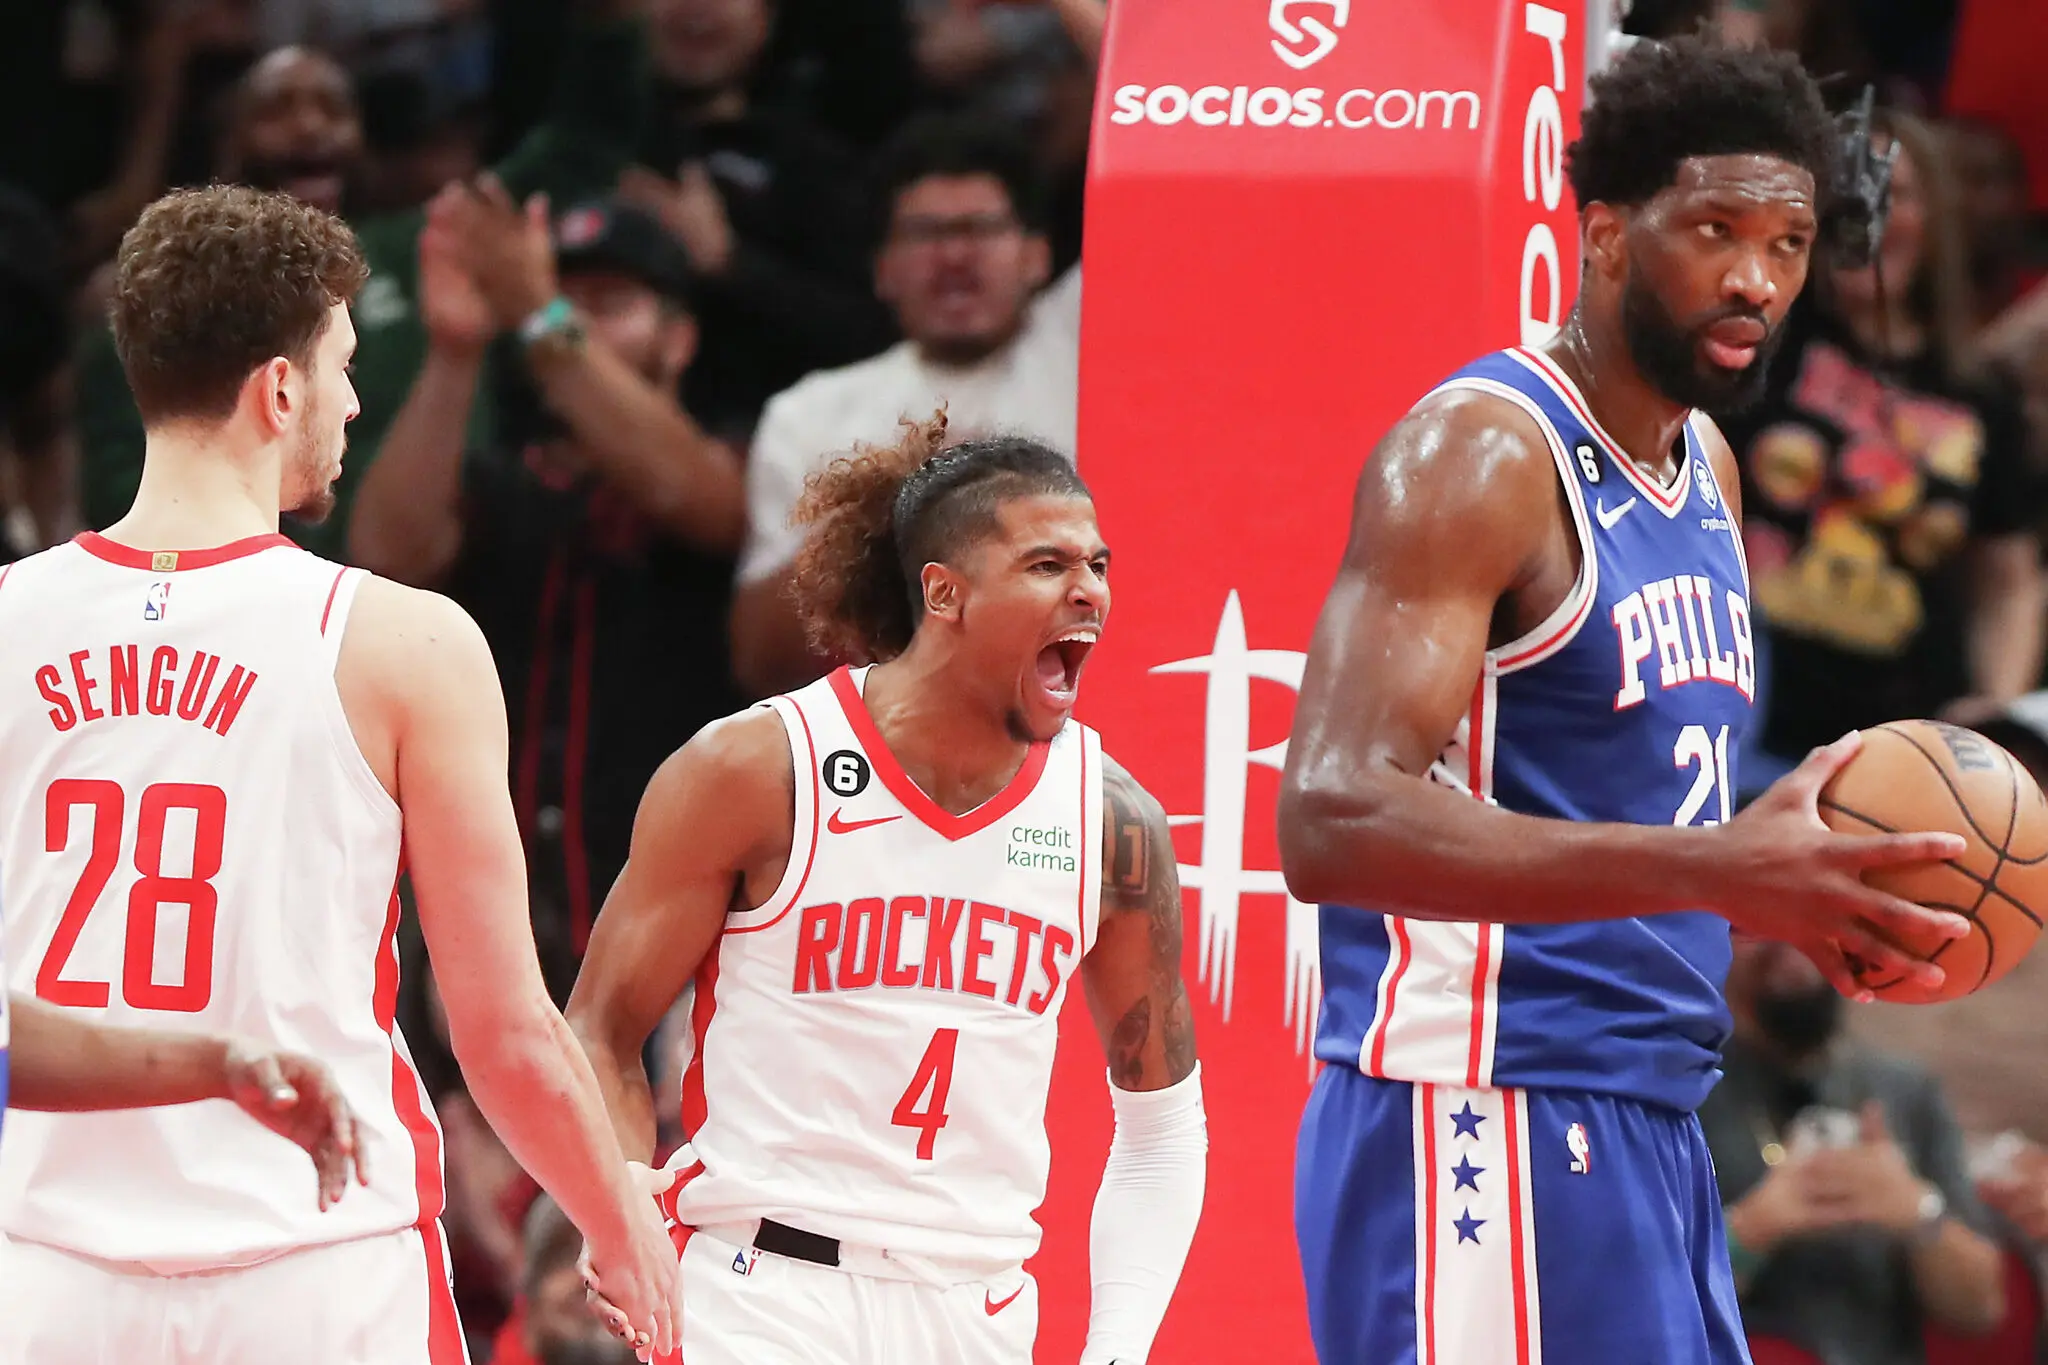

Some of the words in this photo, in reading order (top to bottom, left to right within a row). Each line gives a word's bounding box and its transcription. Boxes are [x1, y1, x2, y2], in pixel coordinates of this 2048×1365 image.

[1111, 84, 1480, 129] SOCIOS.com
[1576, 444, 1600, 484] 6
[35, 644, 258, 737] SENGUN
[832, 755, 861, 792] 6
[1007, 843, 1075, 872] karma
[1012, 826, 1071, 848] credit
[36, 778, 227, 1013] 28
[792, 895, 1075, 1016] ROCKETS
[890, 1028, 959, 1161] 4
